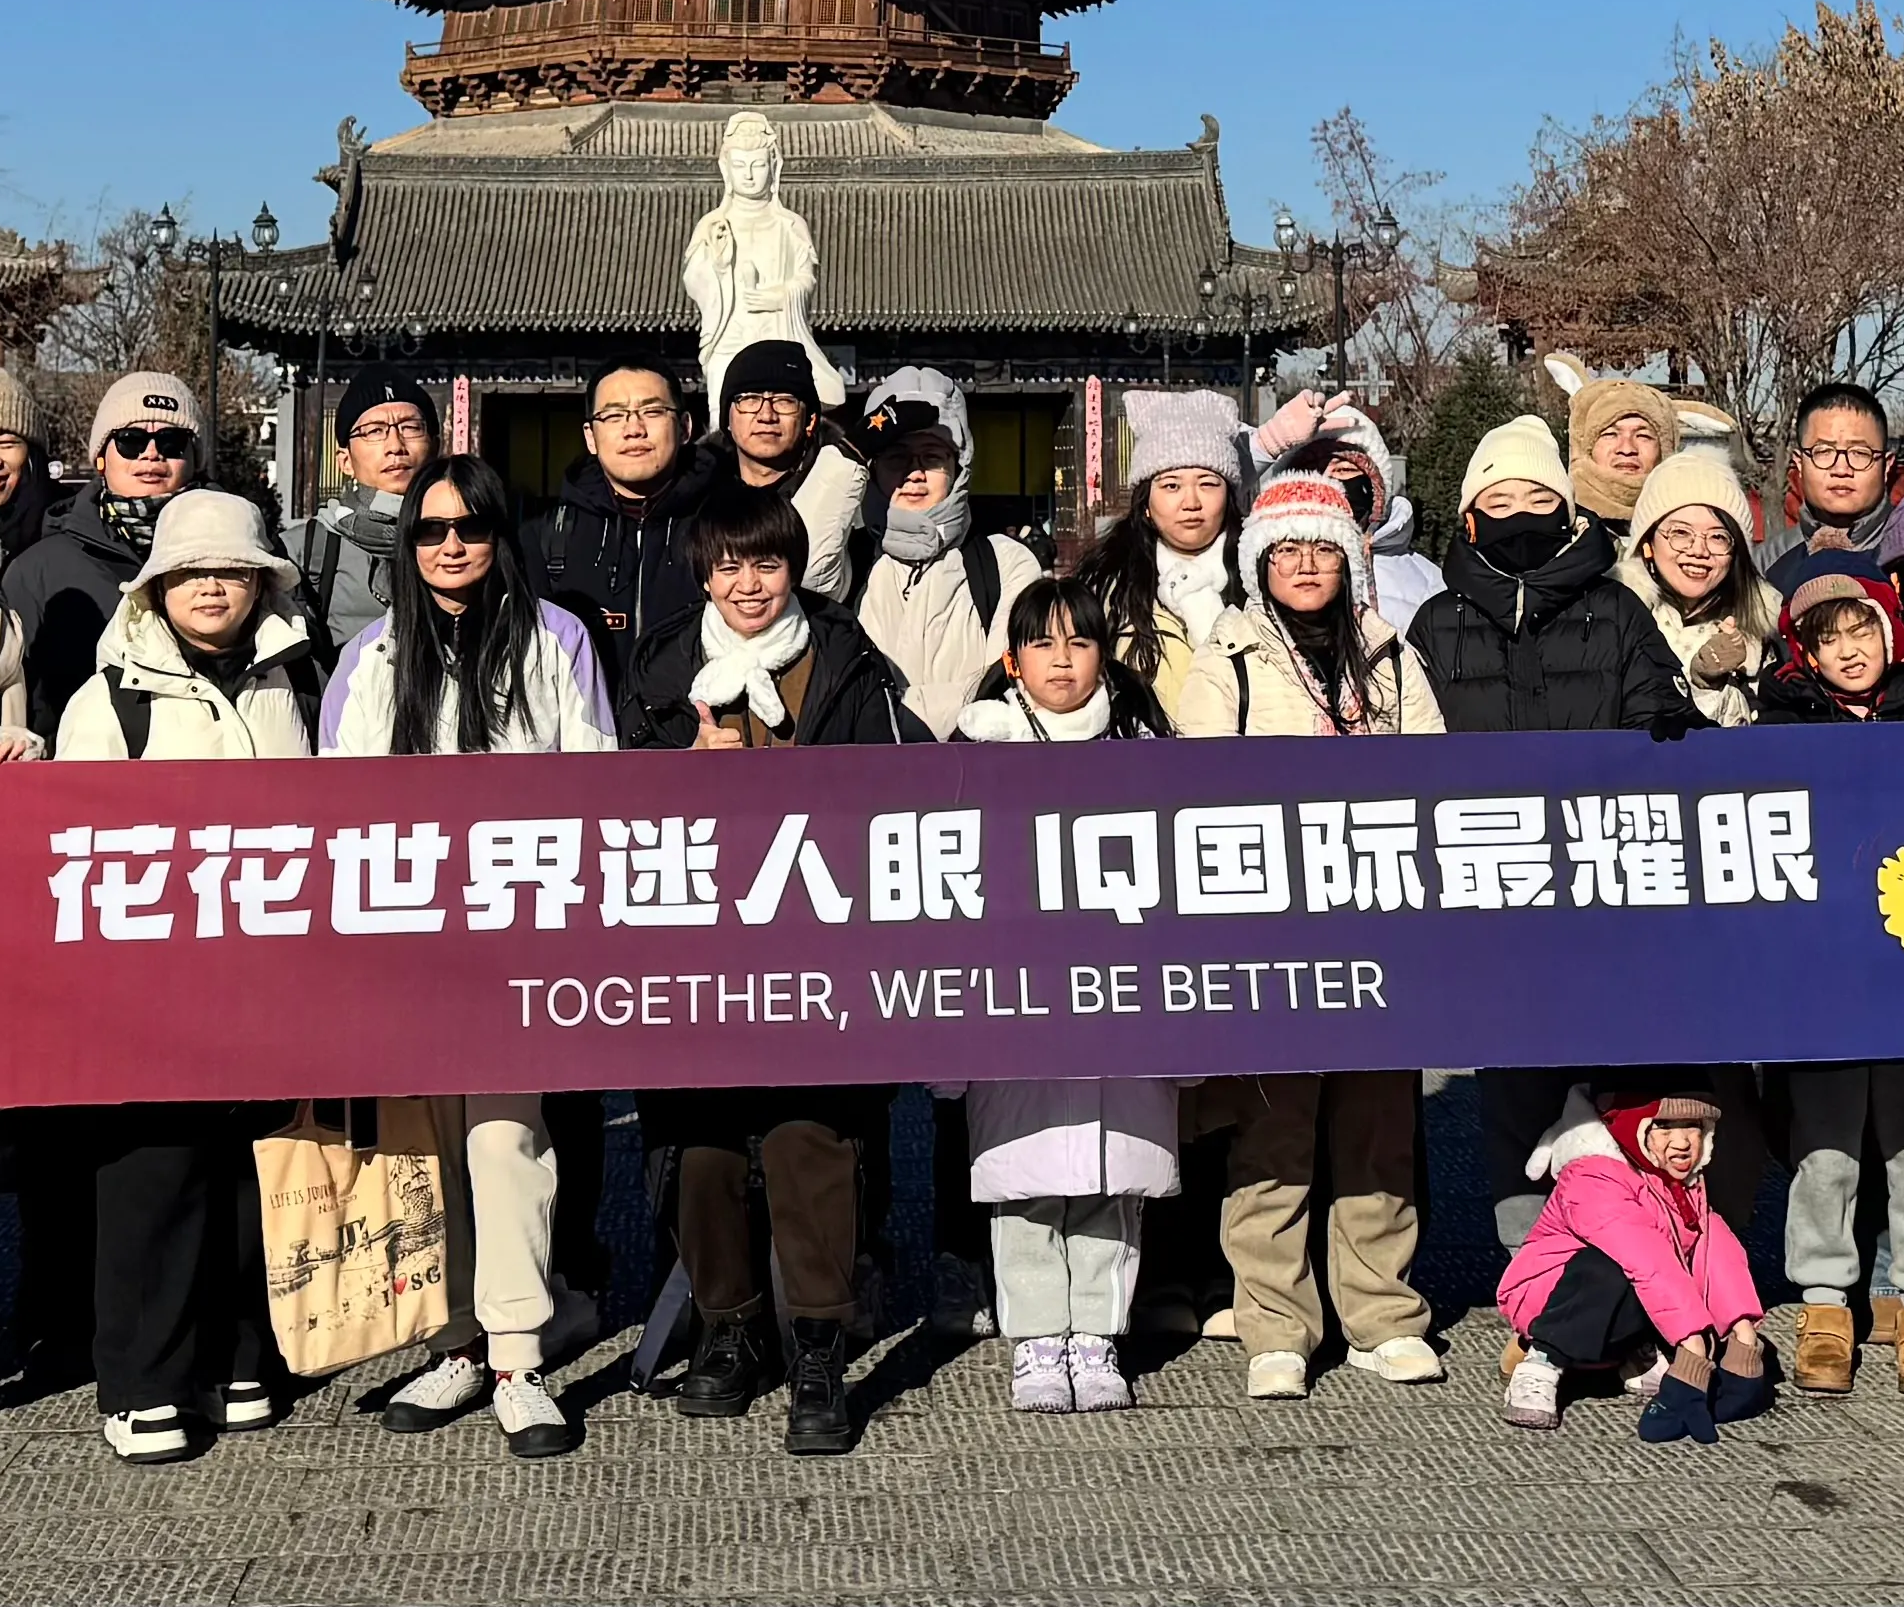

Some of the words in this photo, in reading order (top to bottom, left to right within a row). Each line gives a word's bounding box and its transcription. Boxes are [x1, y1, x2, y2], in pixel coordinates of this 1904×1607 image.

[46, 809, 986, 944] 花花世界迷人眼
[1034, 790, 1819, 924] IQ国际最耀眼
[507, 971, 850, 1032] TOGETHER,
[869, 967, 1051, 1019] WE'LL
[1069, 965, 1142, 1014] BE
[1160, 960, 1388, 1012] BETTER
[411, 1265, 441, 1291] SG
